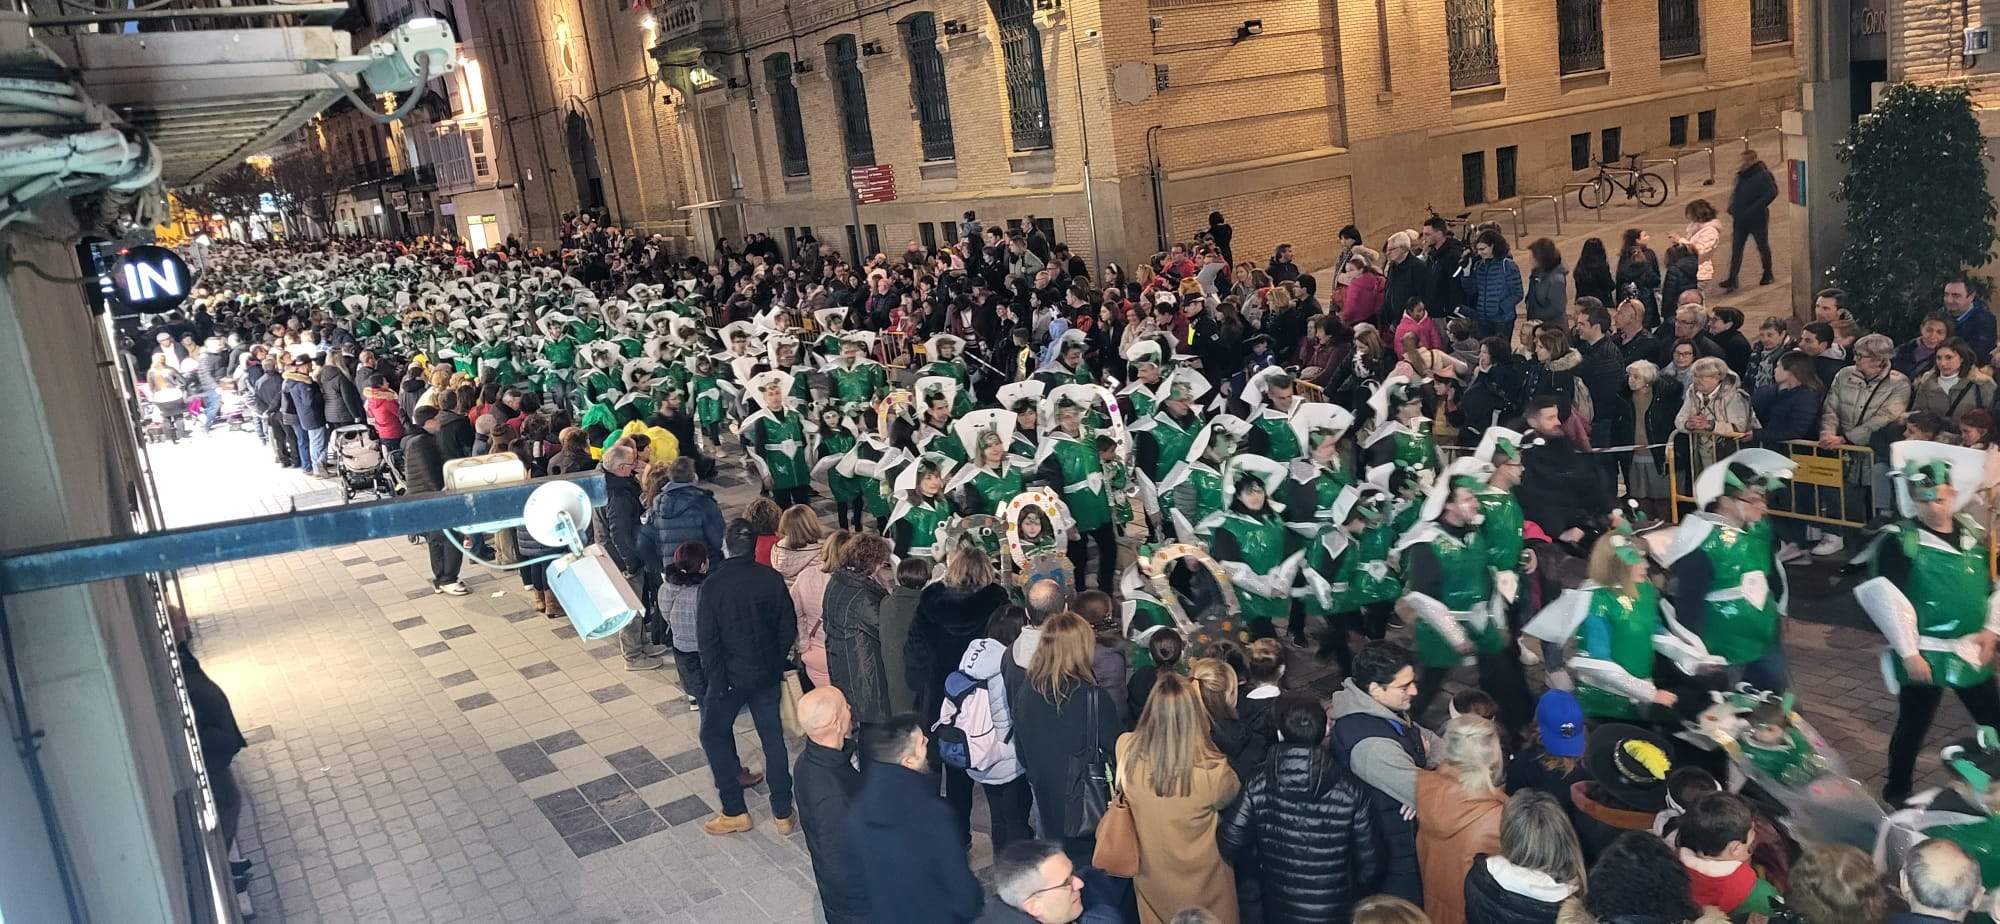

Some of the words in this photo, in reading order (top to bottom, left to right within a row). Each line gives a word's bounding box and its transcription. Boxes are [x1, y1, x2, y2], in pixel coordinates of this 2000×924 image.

[1861, 7, 1887, 34] CORR
[123, 258, 180, 301] IN
[967, 640, 988, 669] LOLA
